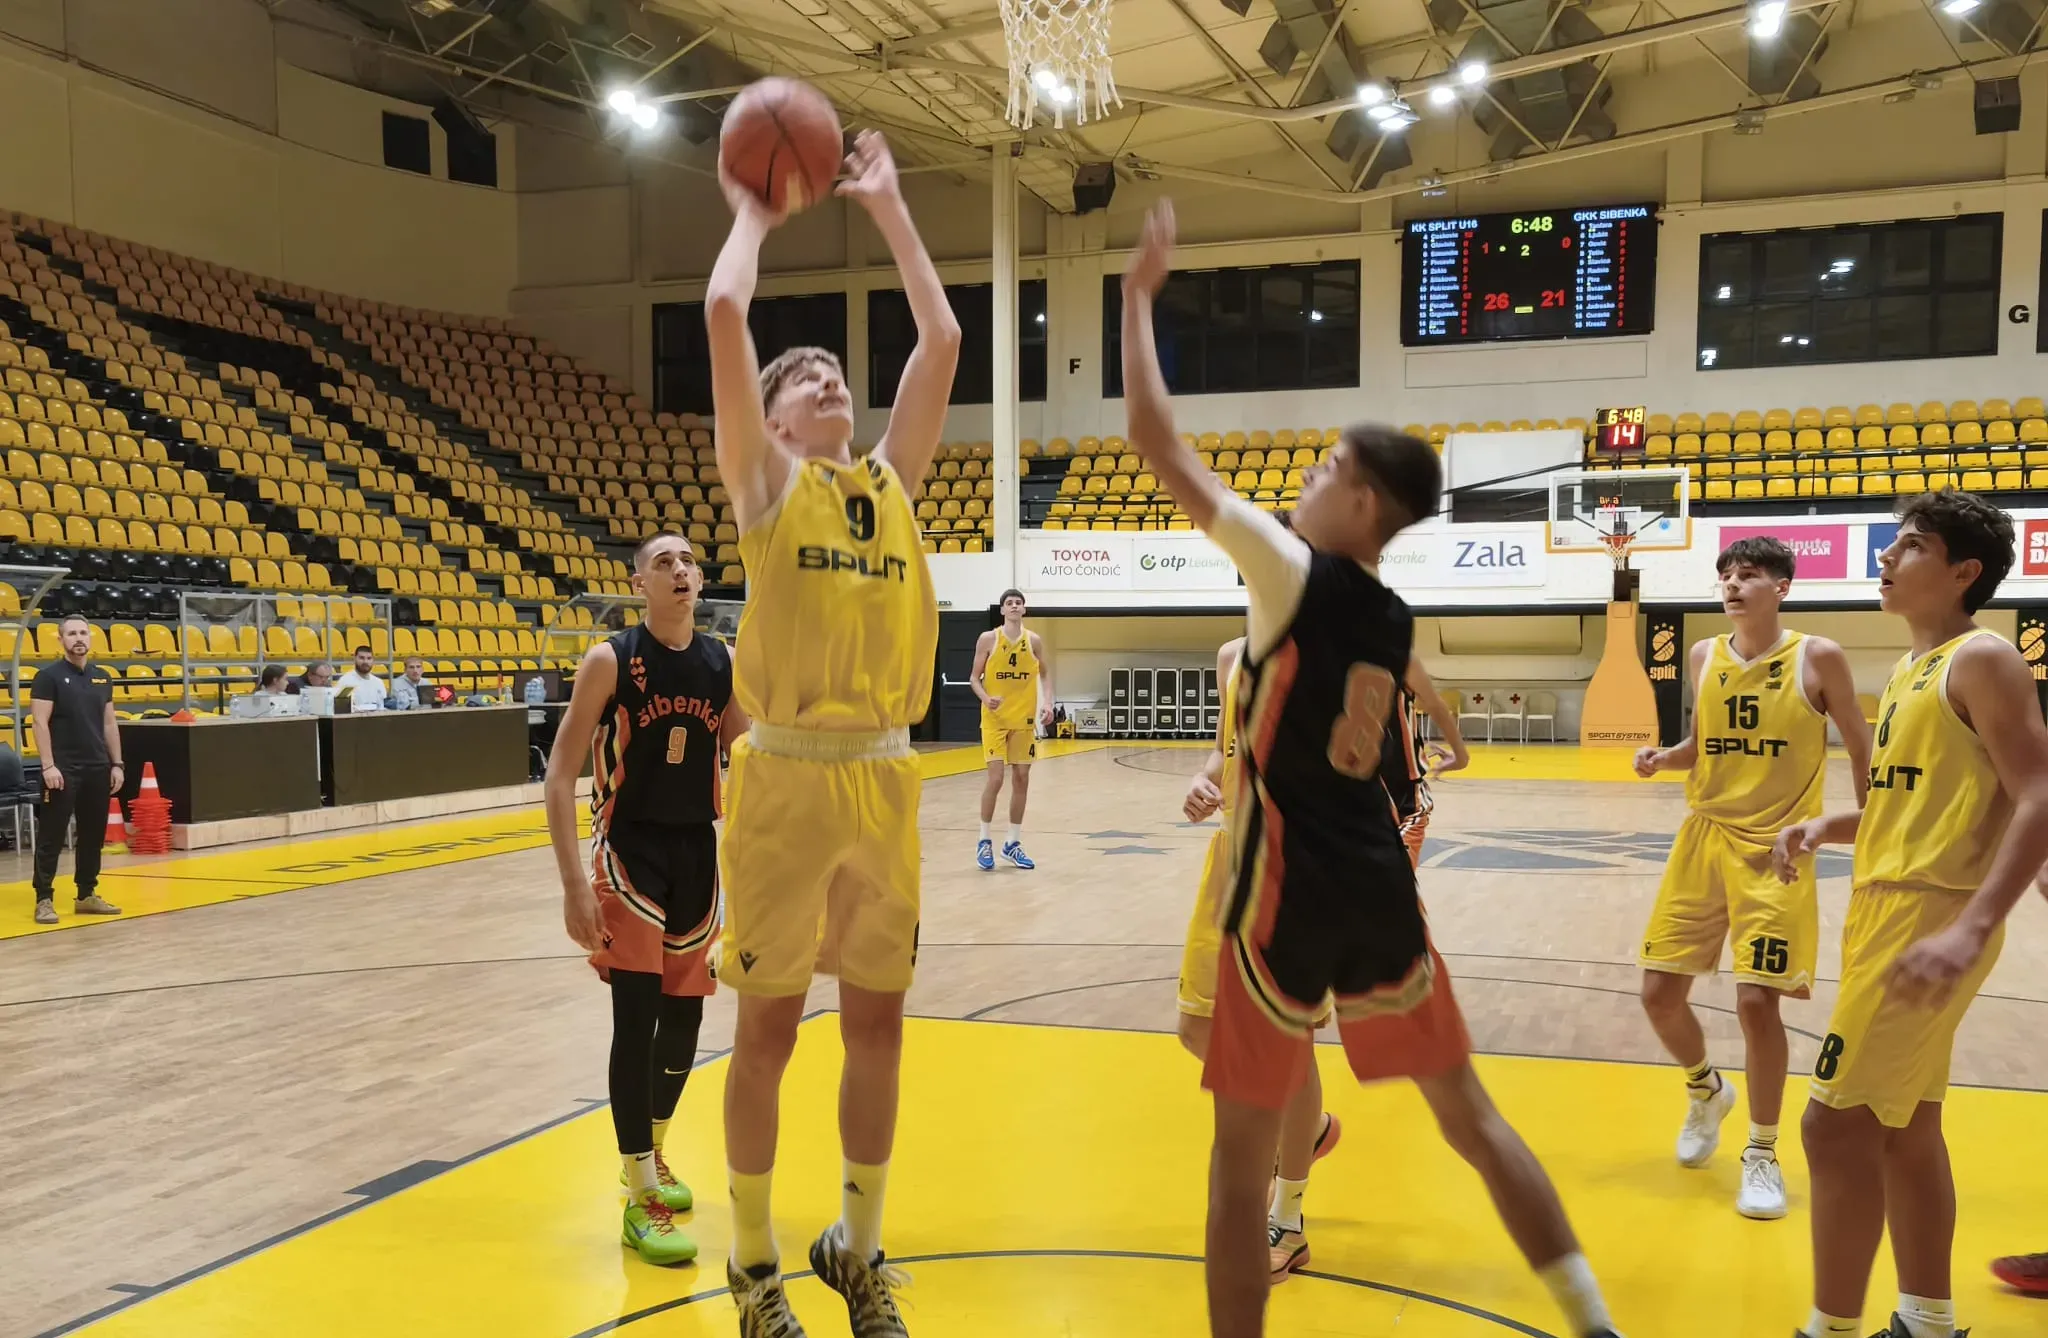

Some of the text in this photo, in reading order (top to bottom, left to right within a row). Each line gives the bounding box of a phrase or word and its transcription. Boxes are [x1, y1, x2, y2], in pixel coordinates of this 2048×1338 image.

[1573, 207, 1648, 221] GKK SIBENKA
[1411, 223, 1427, 233] KK
[1428, 221, 1458, 231] SPLIT
[1511, 216, 1553, 233] 6:48
[1482, 242, 1489, 254] 1
[1520, 244, 1530, 256] 2
[1562, 236, 1571, 249] 0
[1484, 292, 1510, 311] 26
[1540, 289, 1566, 307] 21
[2008, 304, 2030, 324] G
[1069, 358, 1081, 374] F
[1607, 408, 1644, 424] 6:48
[1613, 424, 1636, 445] 14
[845, 495, 876, 542] 9
[1051, 550, 1111, 562] TOYOTA
[1453, 541, 1527, 568] Zala
[798, 546, 907, 584] SPLIT
[1041, 562, 1121, 576] AUTO ČONDIĆ
[1160, 556, 1231, 572] otp Leasing
[1008, 653, 1018, 667] 4
[995, 671, 1031, 681] SPLIT
[1649, 663, 1678, 681] split
[1723, 695, 1760, 730] 15
[1081, 719, 1099, 727] VOX
[666, 726, 688, 764] 9
[1028, 743, 1036, 758] 4
[1705, 737, 1789, 757] SPLIT
[1866, 765, 1923, 791] LIT
[1750, 936, 1789, 974] 15
[1815, 1032, 1845, 1081] 8
